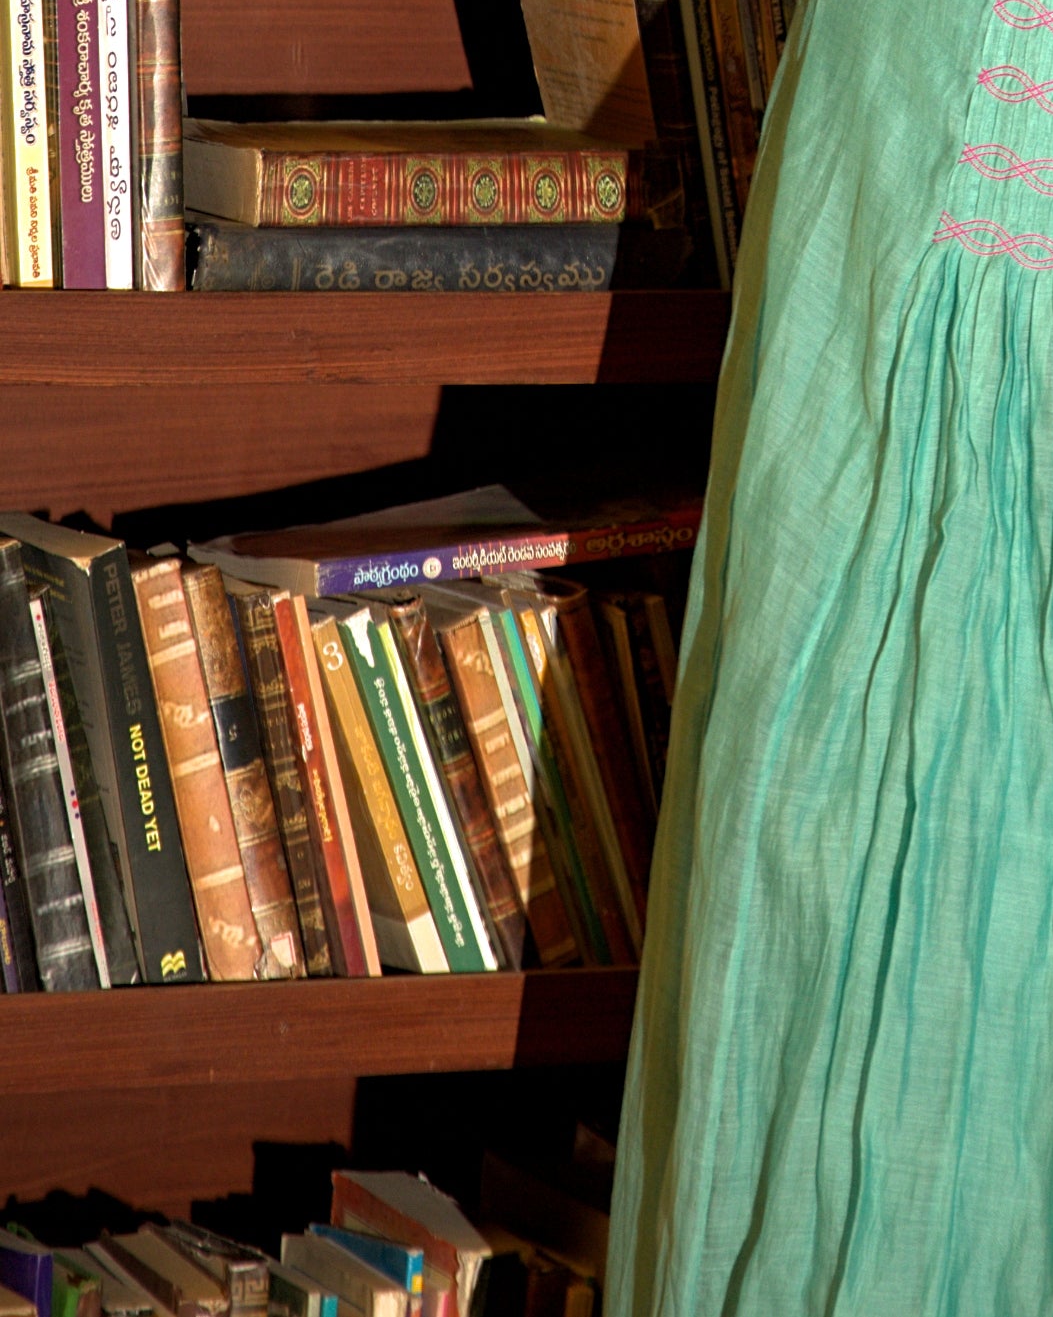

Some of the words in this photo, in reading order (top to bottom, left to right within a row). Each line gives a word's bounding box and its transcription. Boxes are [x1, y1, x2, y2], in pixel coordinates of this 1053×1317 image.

[18, 59, 35, 86] స్తోత్ర
[72, 9, 91, 97] శంకరాచార్య
[104, 51, 119, 130] శరణం
[19, 90, 38, 145] సర్వస్వం
[72, 99, 92, 126] కృత
[26, 167, 37, 193] శ్రీమతి
[74, 130, 94, 203] స్తోత్రములు
[105, 145, 127, 239] అన్యథా
[459, 261, 606, 292] సర్వస్వము
[352, 560, 419, 588] పాఠ్యగ్రంథం
[451, 547, 508, 575] ఇంటర్మీడియట్
[507, 544, 534, 562] రెండవ
[101, 562, 127, 633] PETER
[315, 638, 349, 674] 3
[113, 640, 142, 717] JAMES
[127, 722, 146, 761] NOT
[134, 764, 155, 816] DEAD
[142, 816, 161, 853] YET
